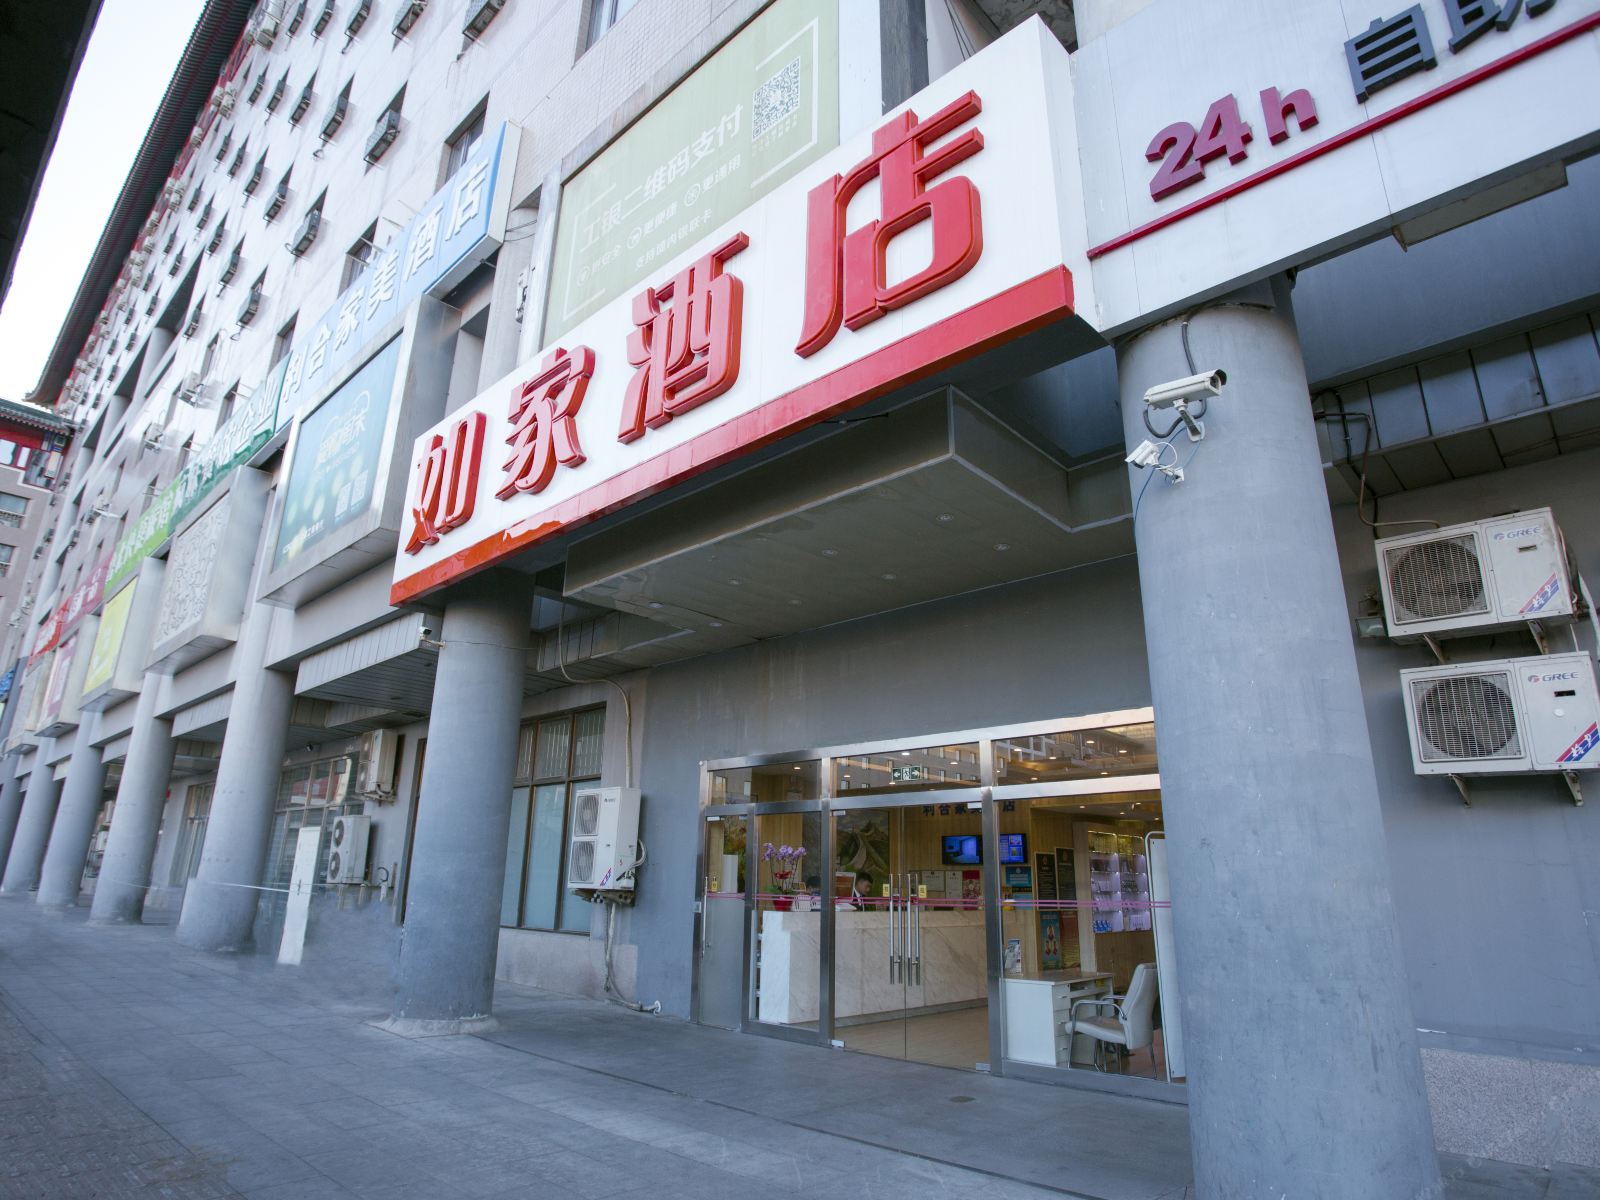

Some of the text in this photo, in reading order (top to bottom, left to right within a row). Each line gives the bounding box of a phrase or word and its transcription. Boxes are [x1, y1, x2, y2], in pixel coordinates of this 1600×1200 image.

[579, 103, 744, 253] 工银二维码支付
[1144, 86, 1319, 203] 24h
[404, 88, 985, 555] 如家酒店
[1507, 526, 1542, 540] GREE
[1542, 671, 1580, 682] GREE
